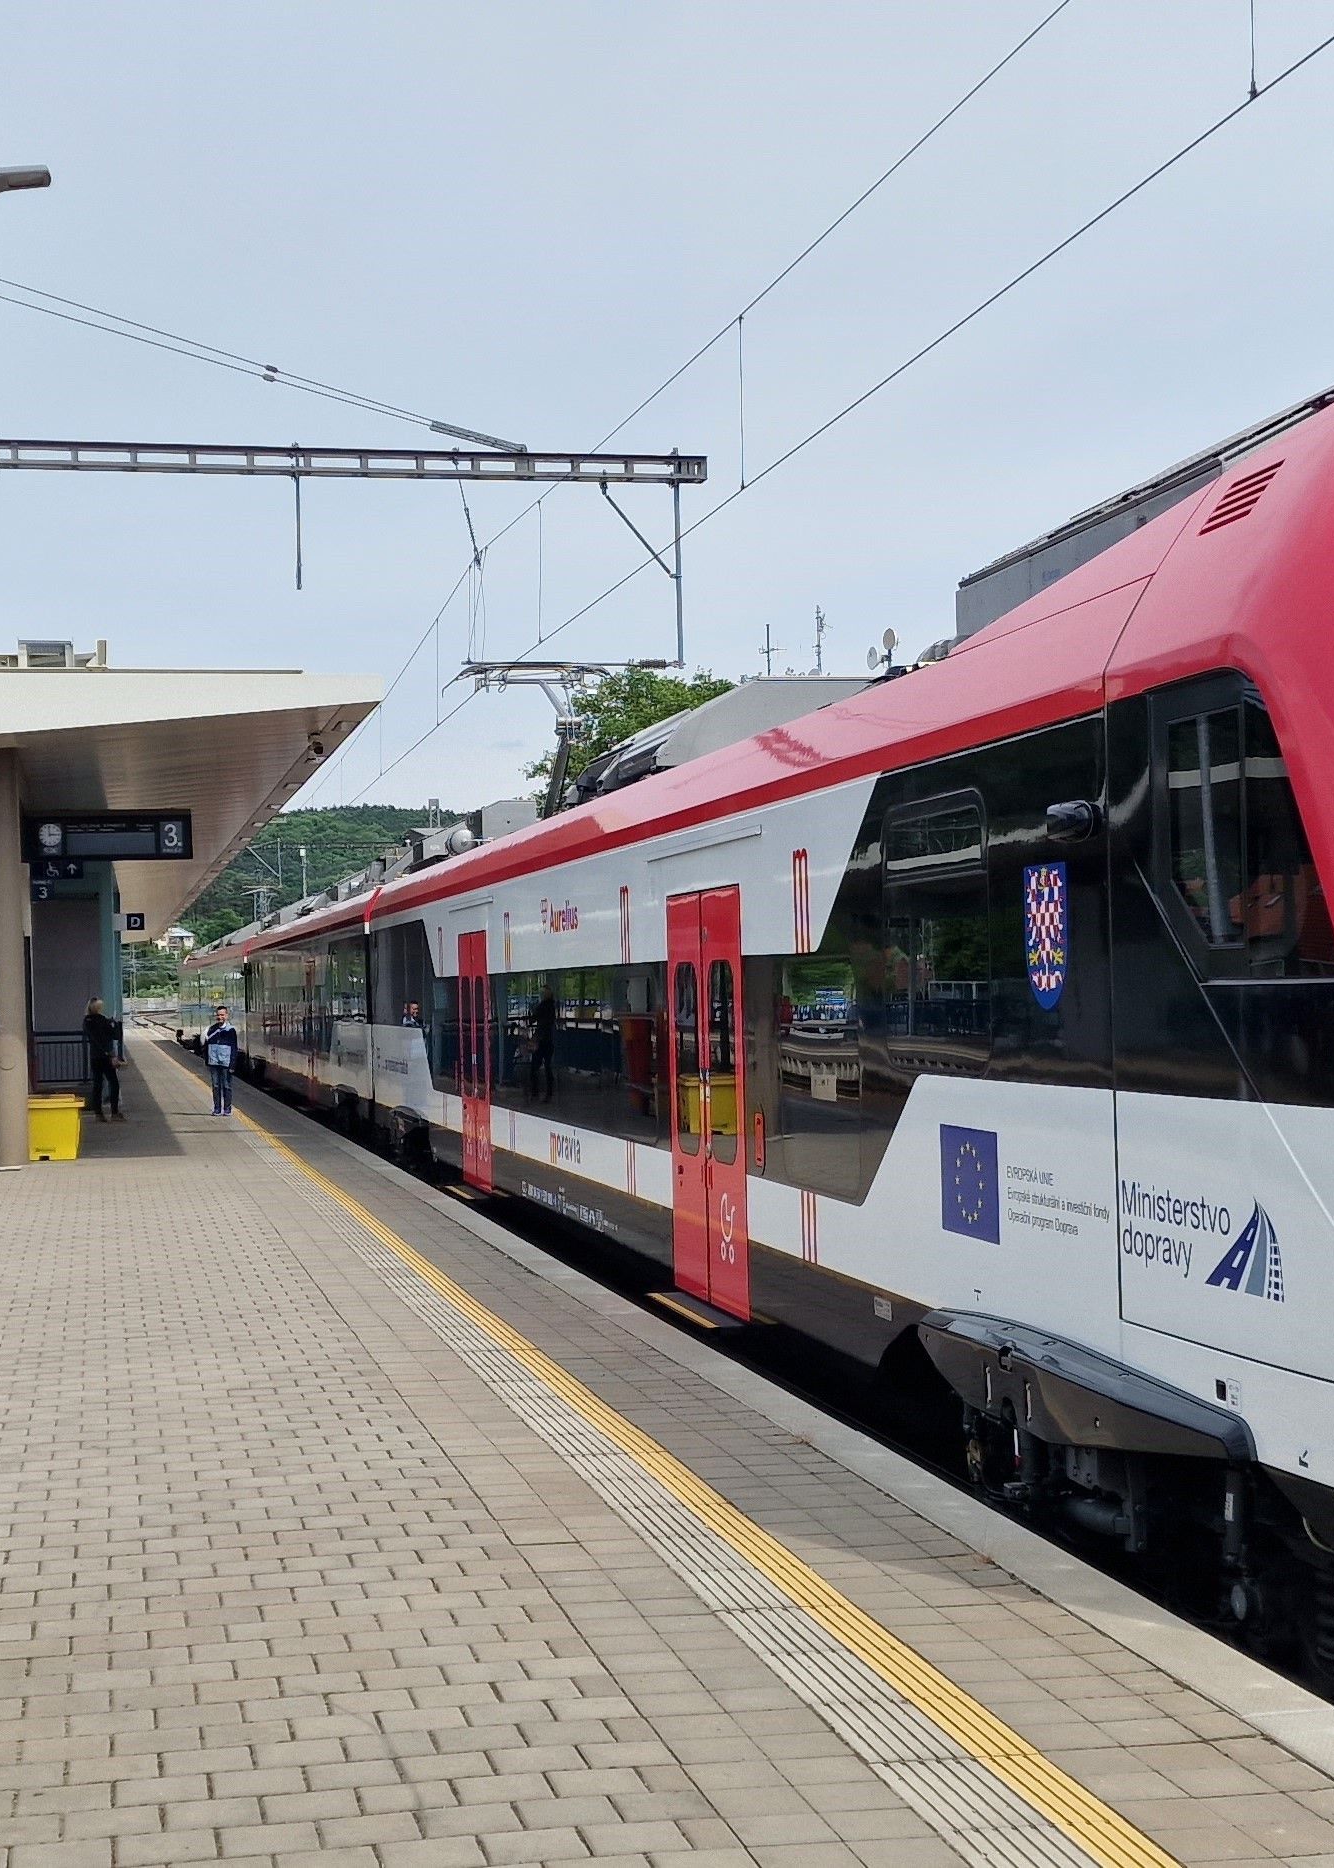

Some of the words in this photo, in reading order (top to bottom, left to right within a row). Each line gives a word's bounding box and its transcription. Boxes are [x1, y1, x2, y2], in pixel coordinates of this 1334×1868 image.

[164, 823, 183, 847] 3.
[38, 886, 48, 899] 3
[130, 916, 141, 928] D
[549, 899, 579, 934] Aurelius
[549, 1129, 581, 1165] moravia
[1121, 1179, 1231, 1236] Ministerstvo
[1122, 1220, 1193, 1279] dopravy
